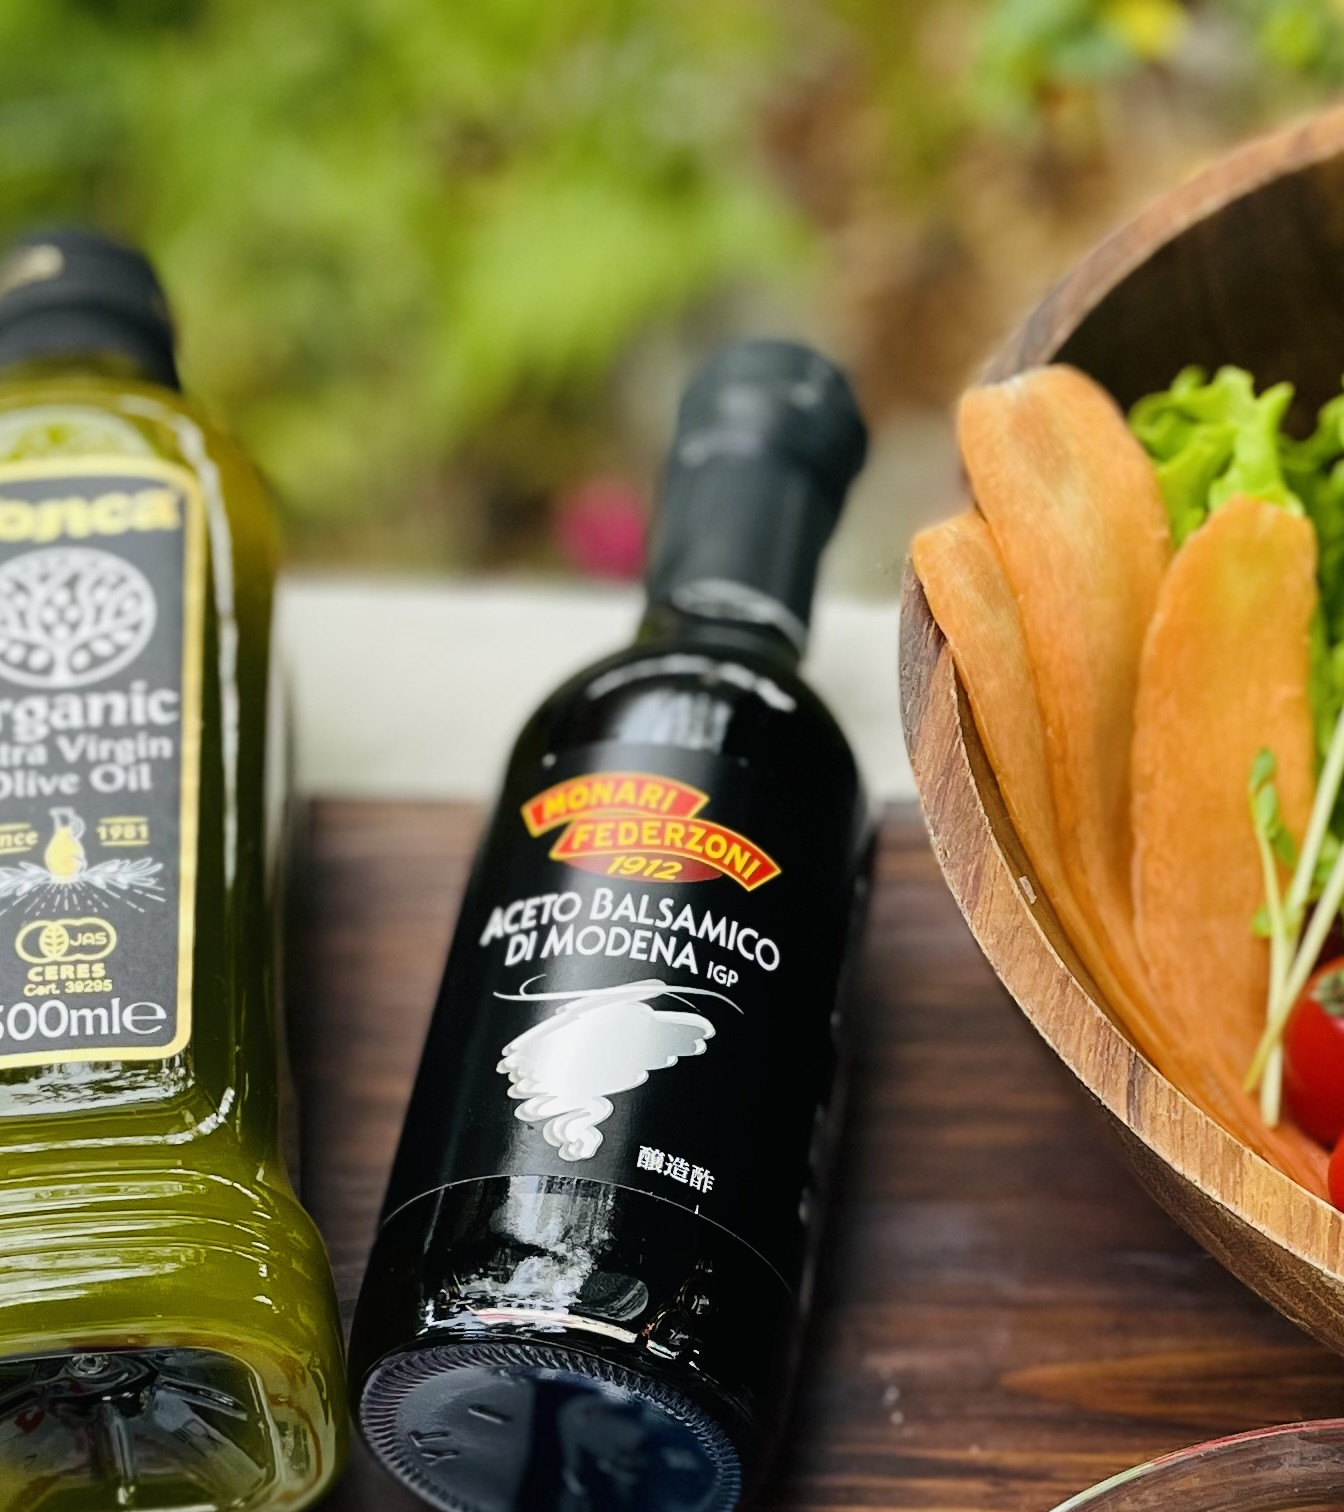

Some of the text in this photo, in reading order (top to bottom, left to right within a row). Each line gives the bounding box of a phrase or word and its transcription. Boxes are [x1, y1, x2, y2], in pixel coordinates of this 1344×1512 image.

[55, 729, 173, 767] Virgin
[88, 760, 153, 795] Oil
[541, 777, 678, 819] MONARI
[96, 820, 150, 842] 1981
[570, 820, 763, 882] FEDERZONI
[605, 854, 683, 881] 1912
[68, 928, 109, 948] JAS
[479, 886, 781, 973] ACETO BALSAMICO
[26, 962, 107, 984] CERES
[504, 924, 740, 989] DI MODENA IGP
[635, 1144, 716, 1195] 醸造酢
